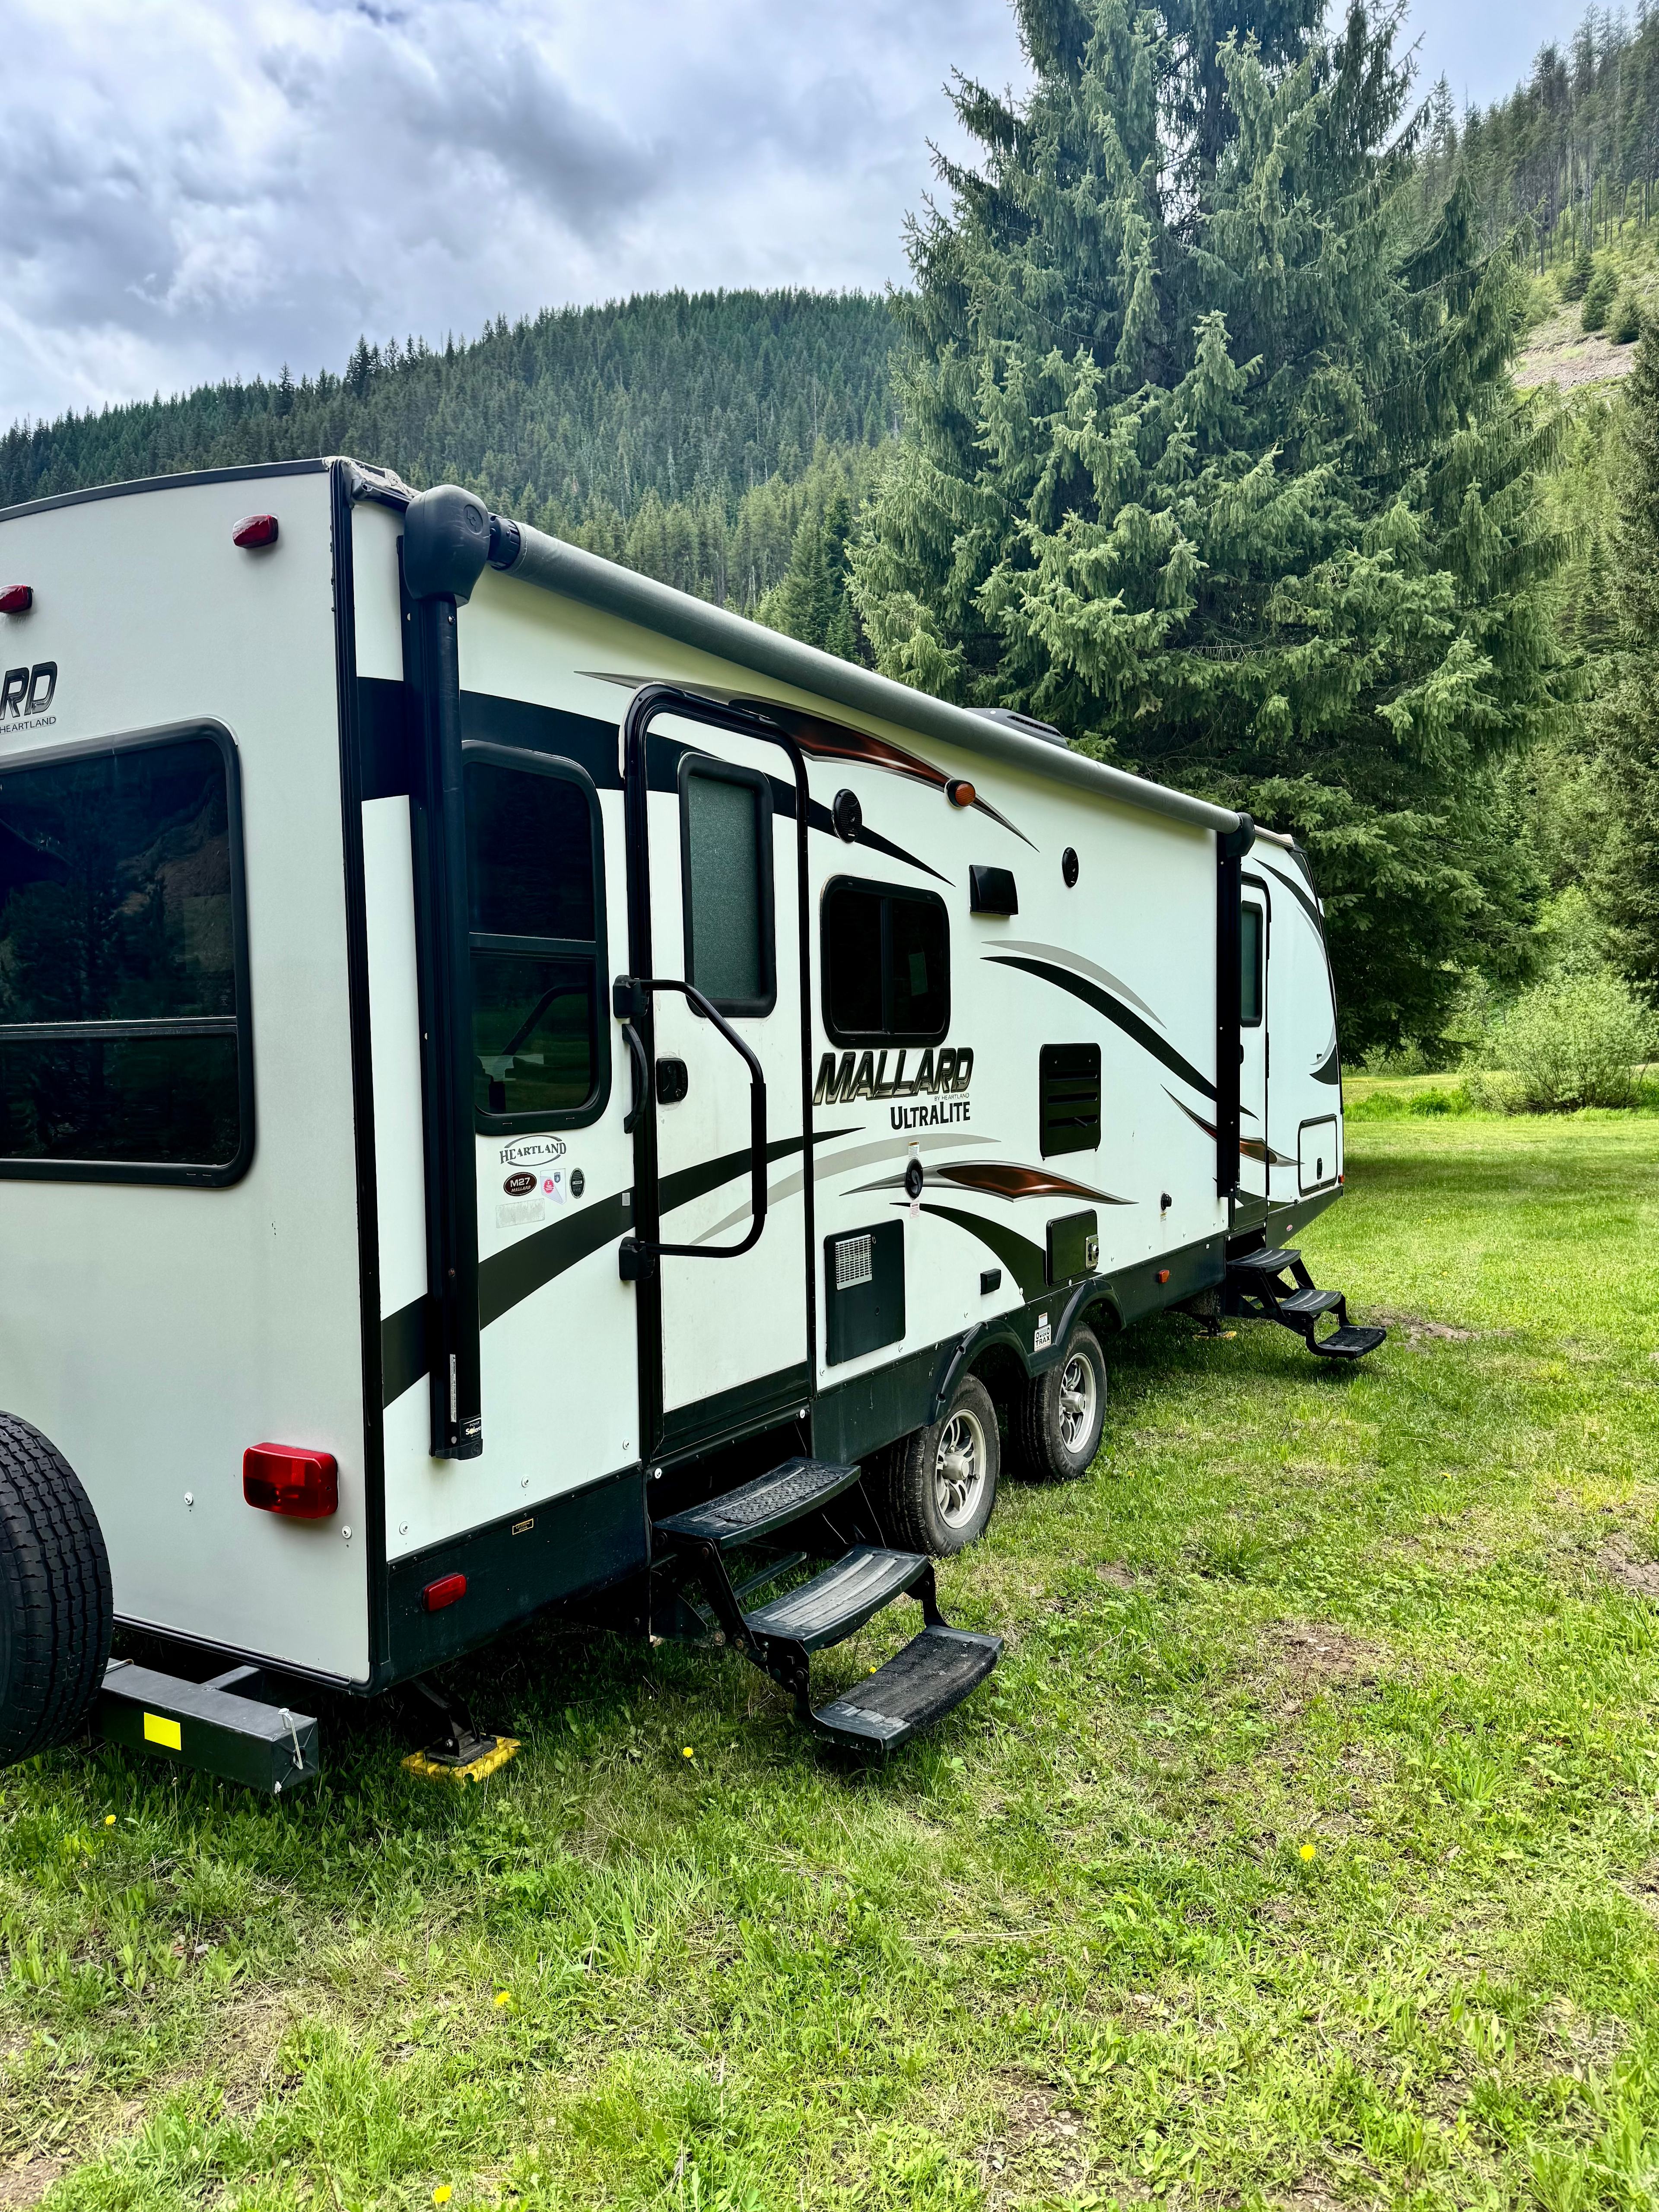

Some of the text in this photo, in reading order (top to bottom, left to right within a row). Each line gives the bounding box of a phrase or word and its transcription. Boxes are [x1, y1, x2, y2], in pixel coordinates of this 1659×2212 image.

[0, 717, 56, 734] HEARTLAND
[813, 1047, 974, 1106] MALLARD
[499, 1142, 566, 1164] HEARTLAND
[510, 1177, 531, 1187] M27
[1036, 1335, 1050, 1346] TRAX
